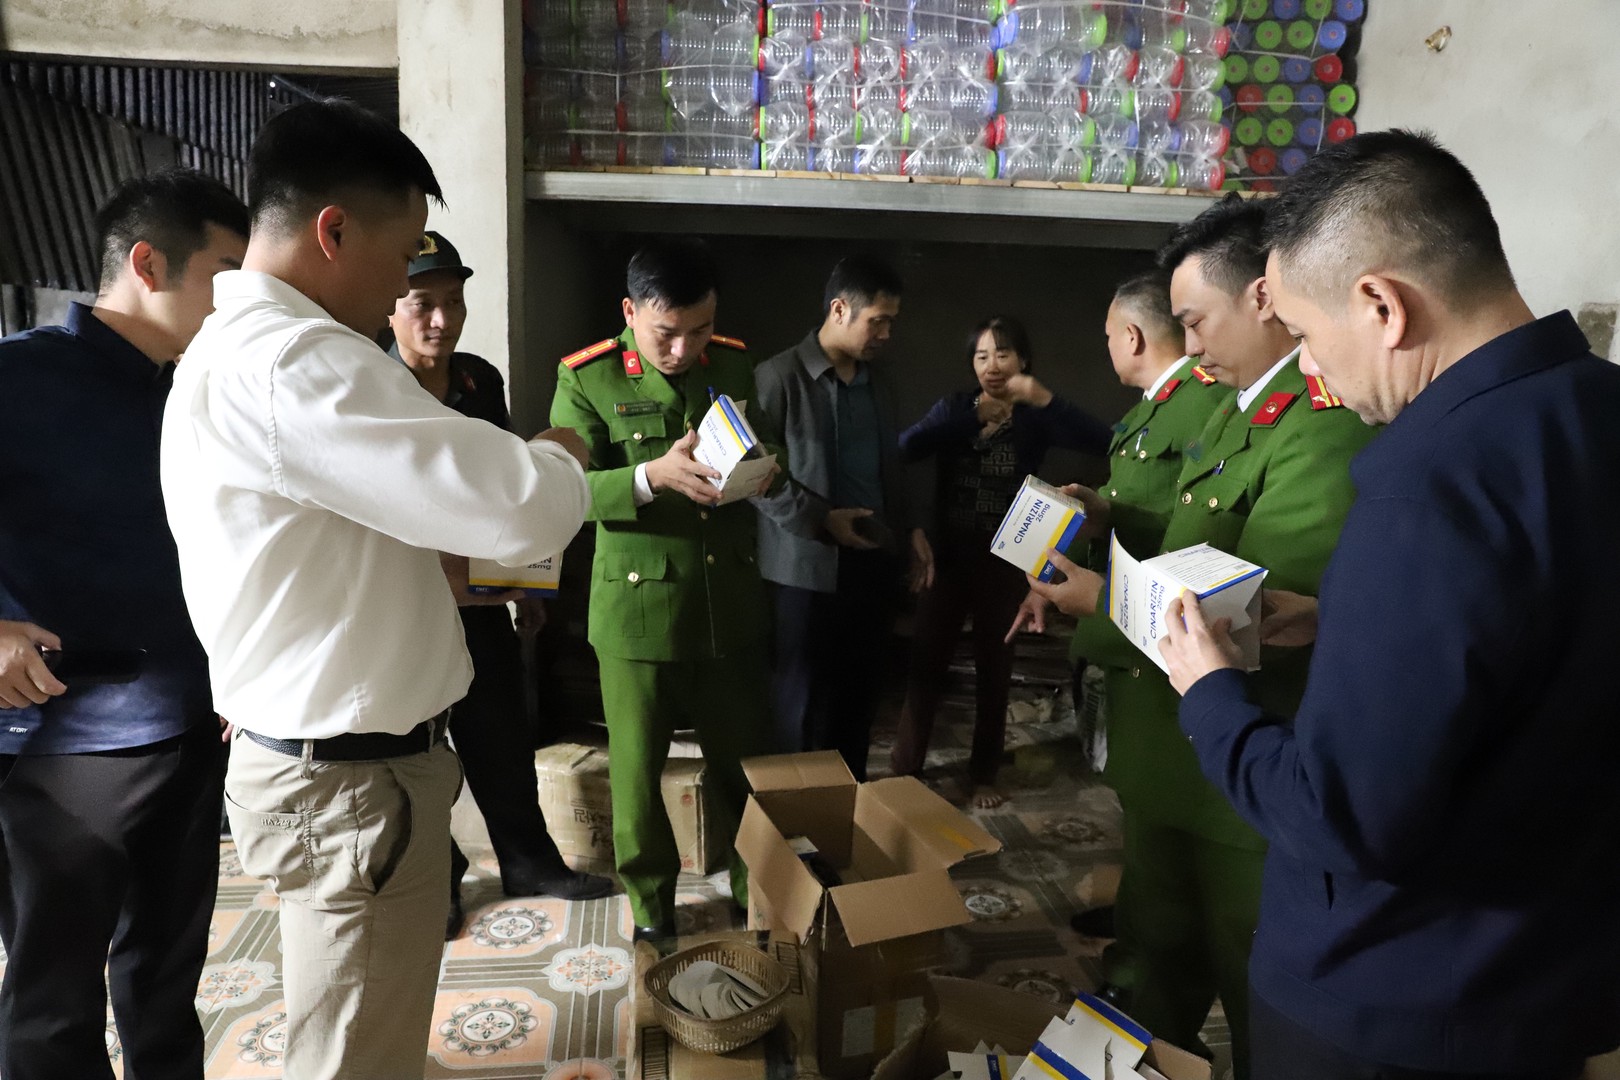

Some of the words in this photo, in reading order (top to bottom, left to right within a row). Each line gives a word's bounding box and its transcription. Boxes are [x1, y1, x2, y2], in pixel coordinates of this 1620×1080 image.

[1013, 499, 1044, 544] CINARIZIN
[1035, 503, 1051, 522] 25mg
[1150, 580, 1158, 639] CINARIZIN
